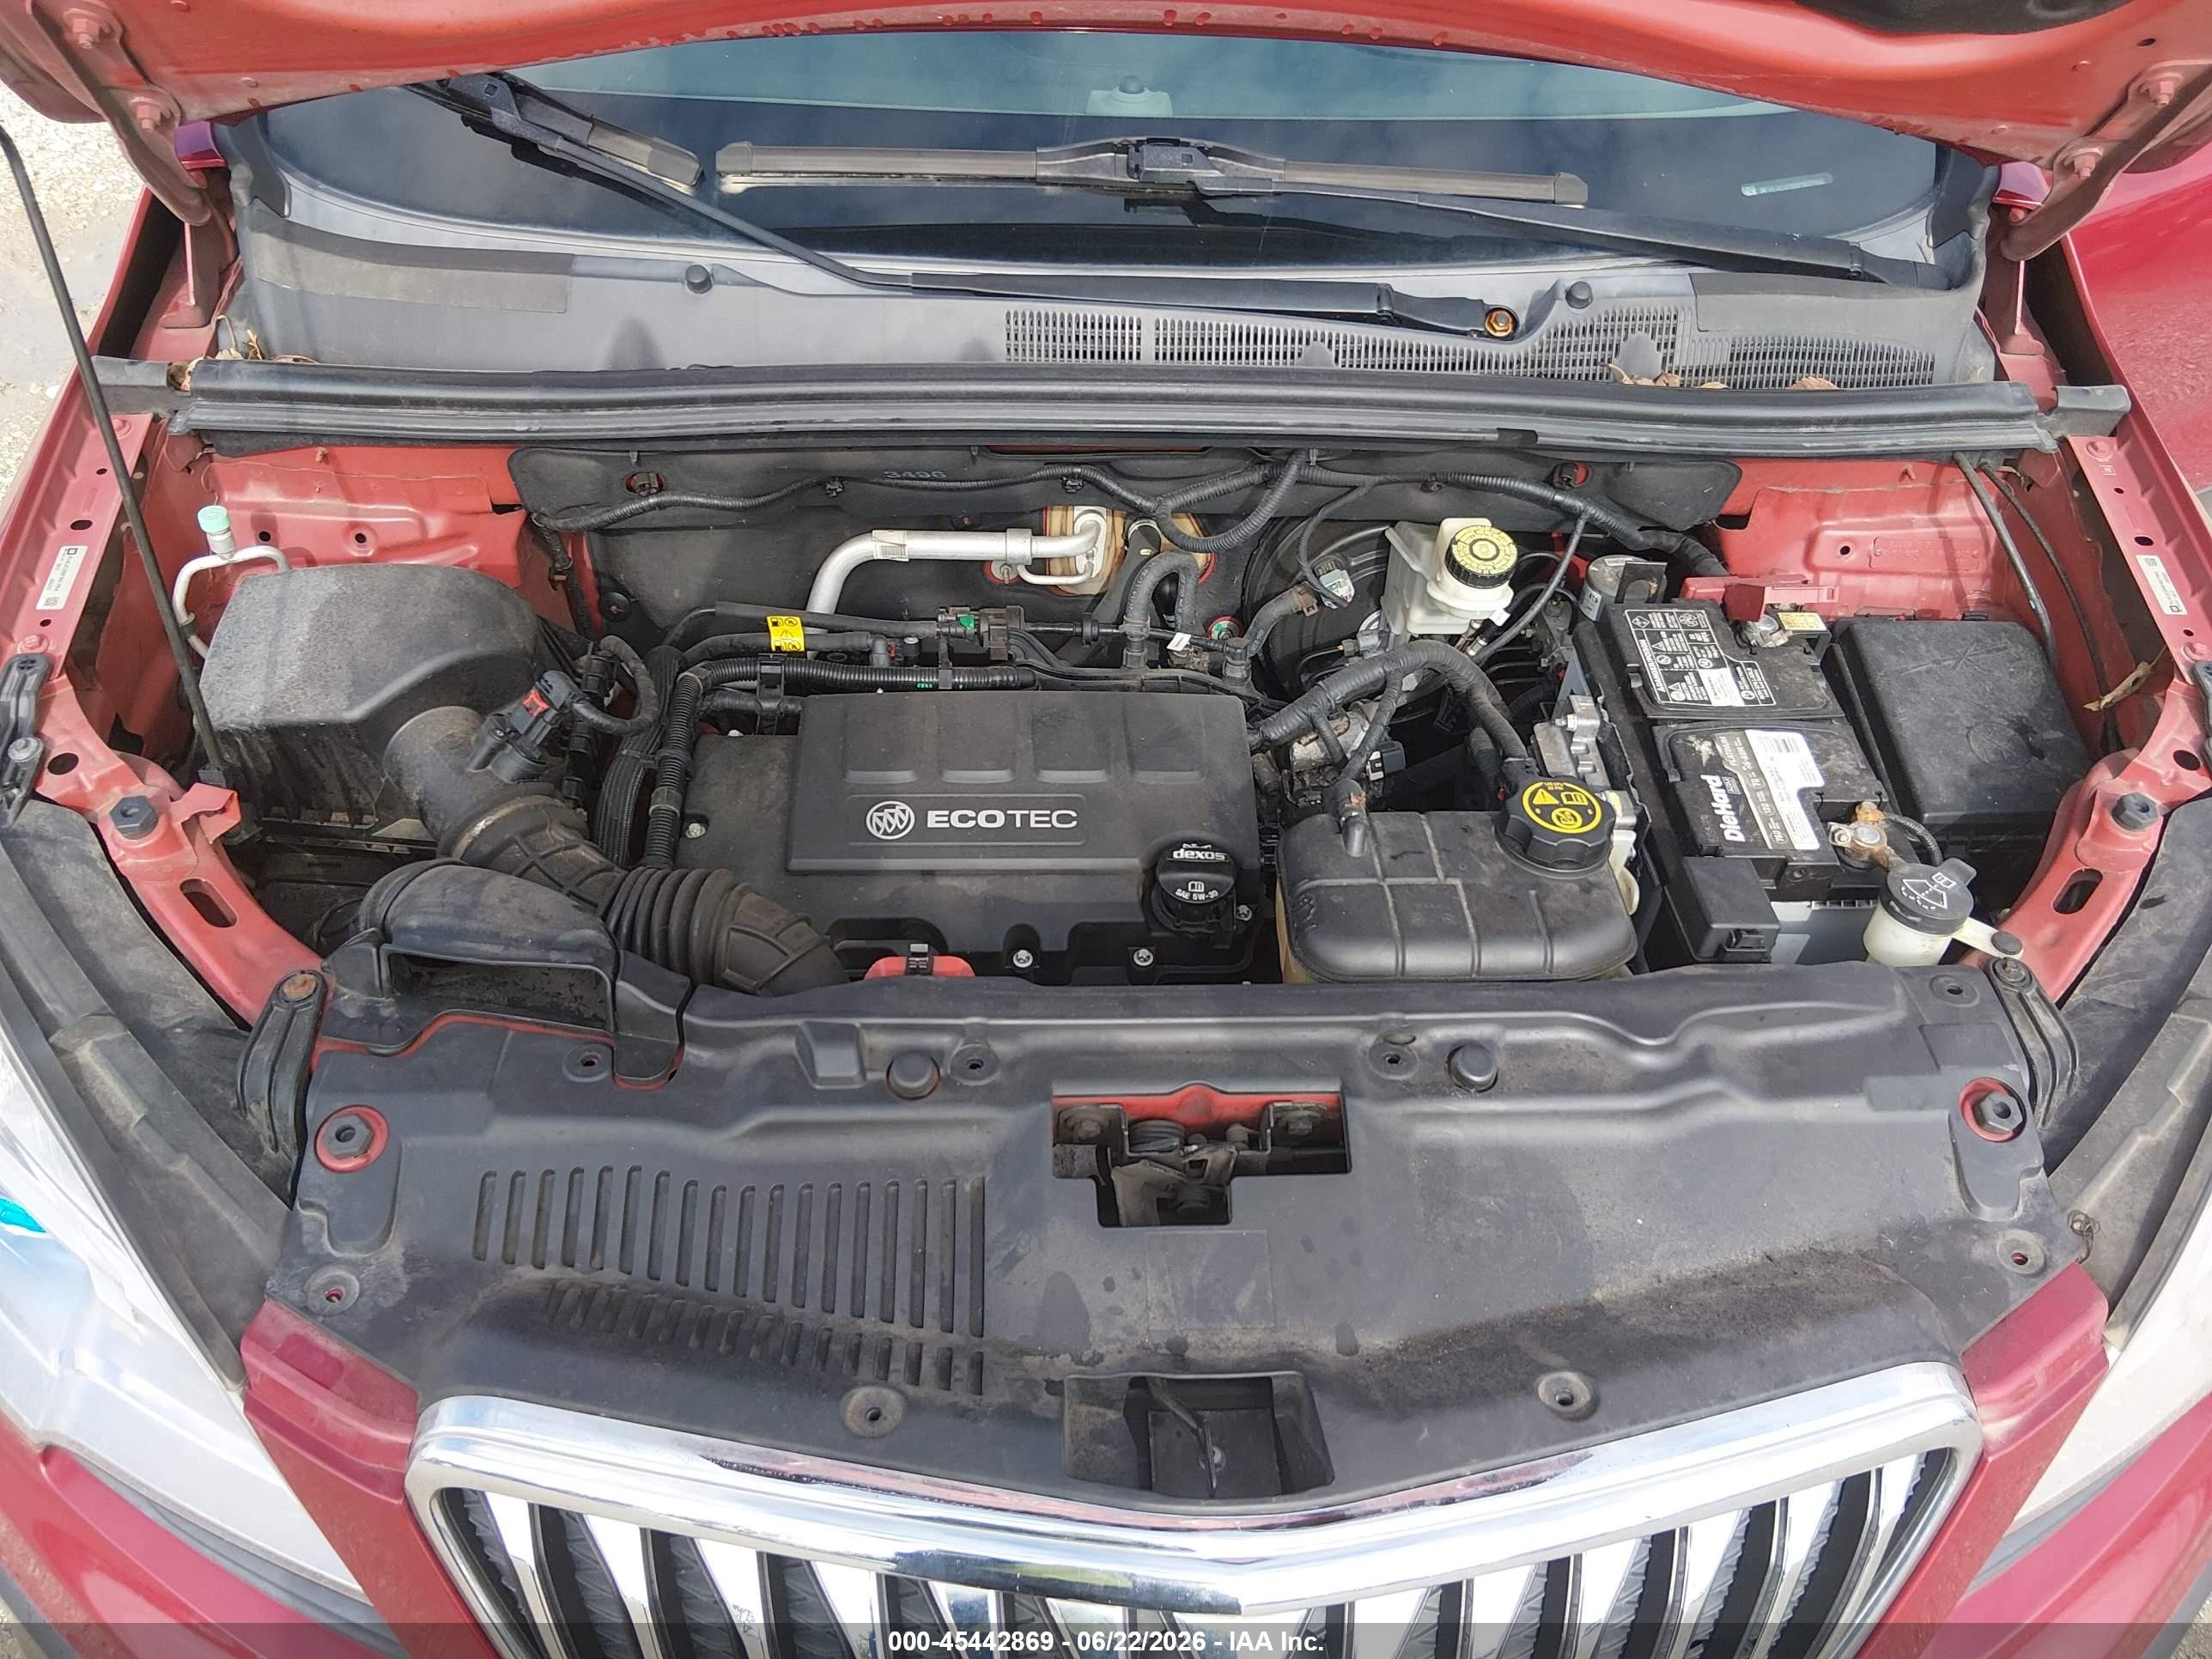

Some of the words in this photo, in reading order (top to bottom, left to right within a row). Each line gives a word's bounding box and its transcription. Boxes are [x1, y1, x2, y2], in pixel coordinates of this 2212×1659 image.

[1699, 775, 1747, 842] DieHard
[927, 809, 1079, 829] ECOTEC
[1172, 848, 1227, 860] dexos
[1175, 888, 1189, 900] SAE
